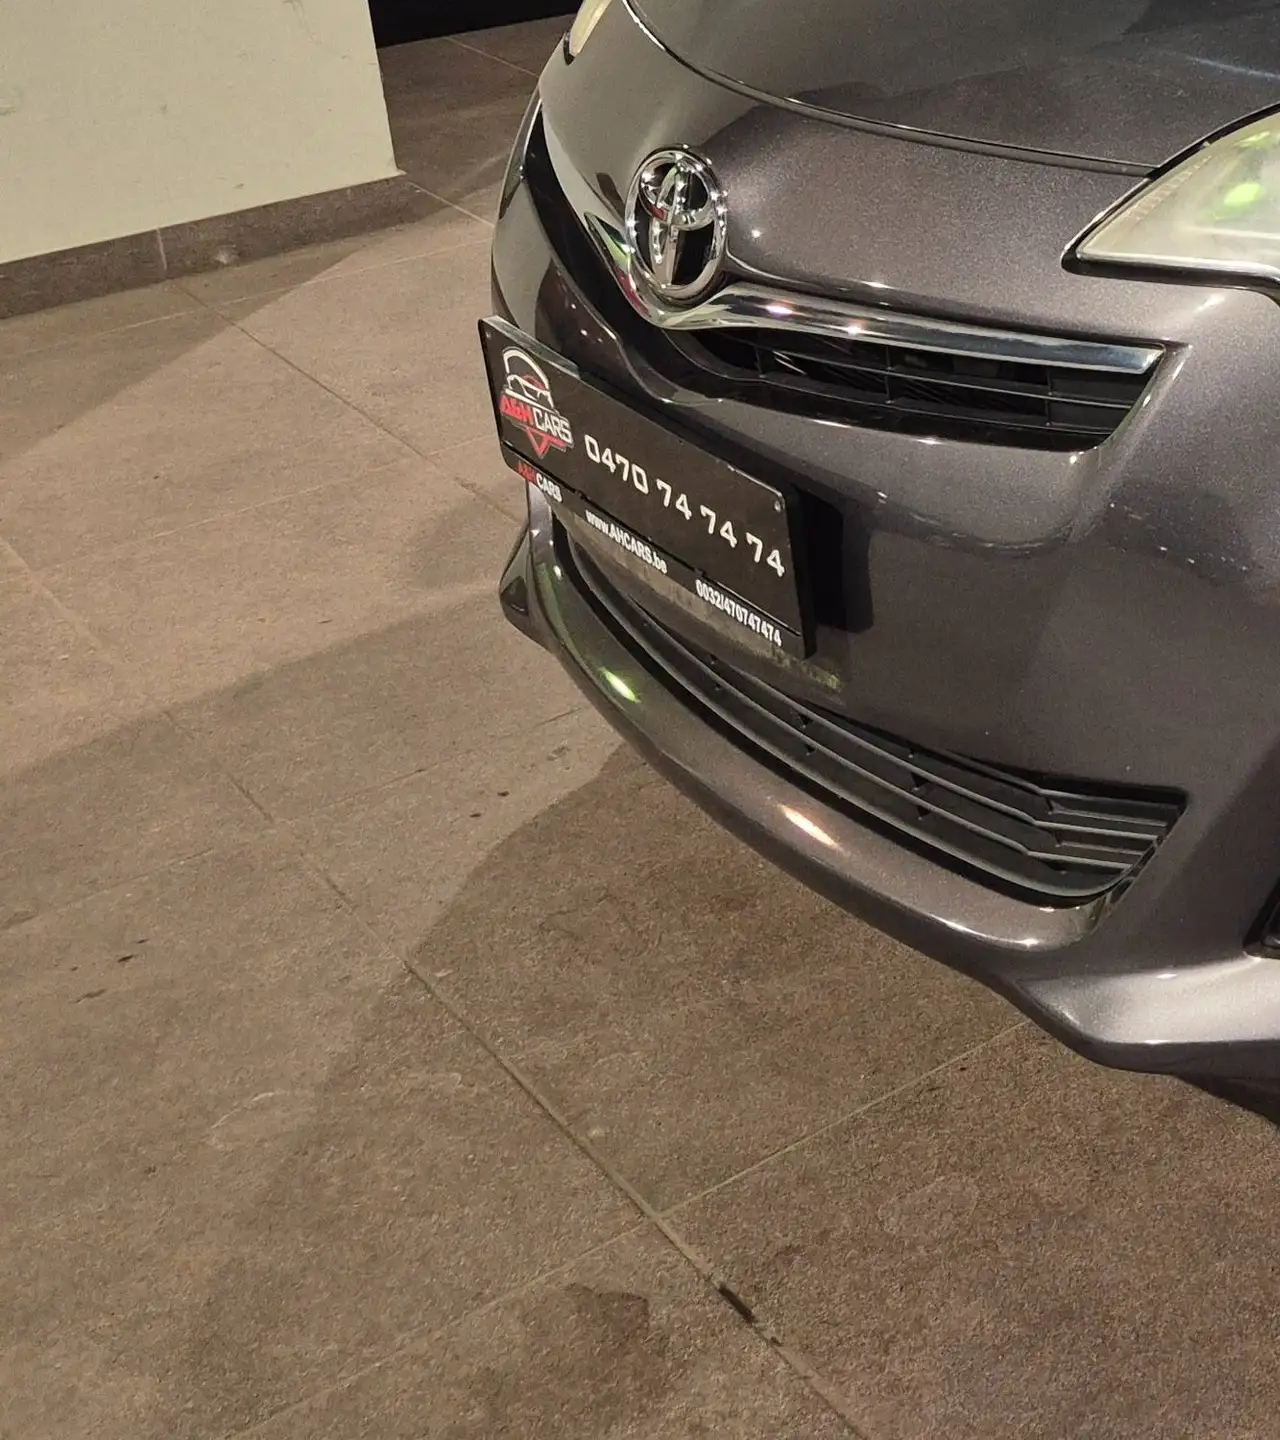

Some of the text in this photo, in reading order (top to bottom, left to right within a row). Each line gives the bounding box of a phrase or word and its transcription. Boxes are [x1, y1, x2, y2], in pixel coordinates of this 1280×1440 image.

[532, 407, 573, 445] CARS
[584, 434, 785, 578] 0470 74 74 74
